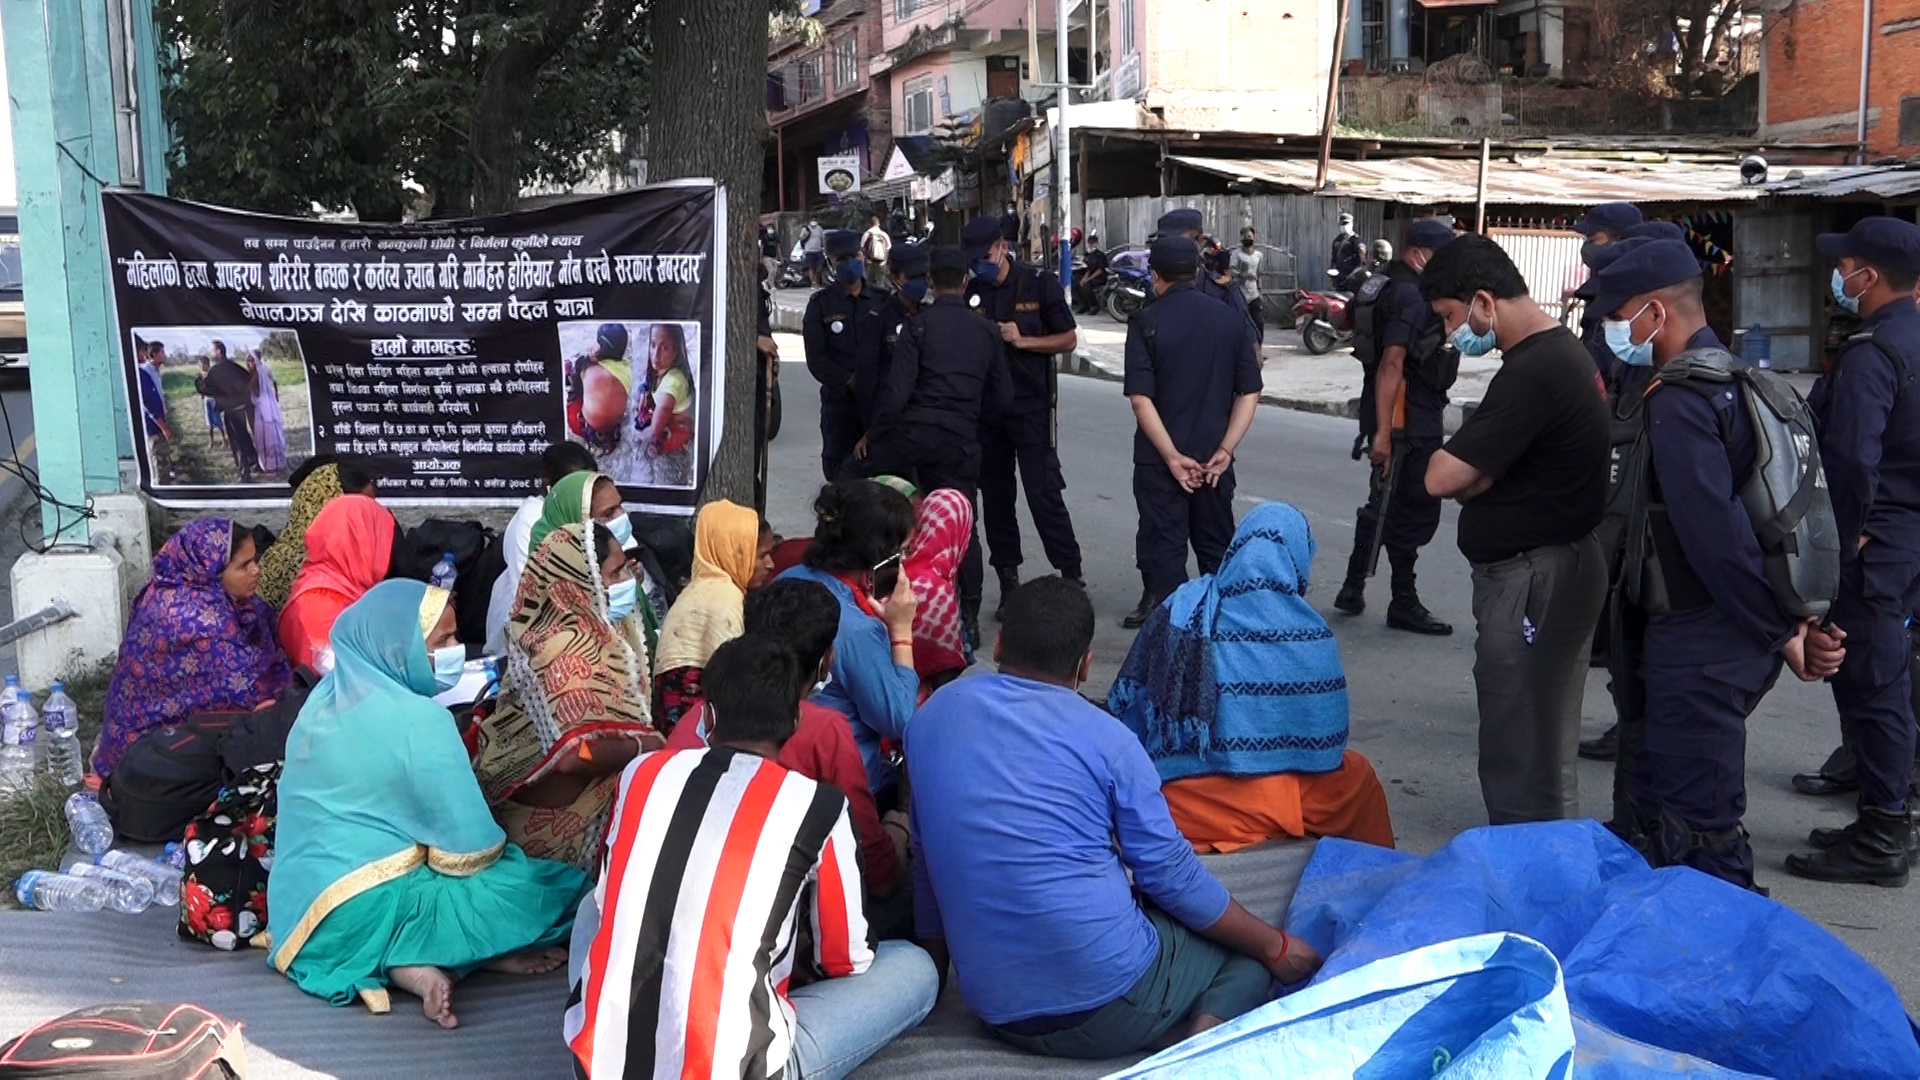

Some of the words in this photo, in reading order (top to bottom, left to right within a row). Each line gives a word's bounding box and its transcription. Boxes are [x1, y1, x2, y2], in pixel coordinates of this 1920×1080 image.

[352, 262, 362, 292] र
[403, 262, 435, 290] ज्यान
[613, 254, 654, 284] सरकार
[460, 301, 503, 323] सम्म
[506, 294, 548, 321] पैदल
[553, 297, 594, 317] यात्रा
[371, 333, 407, 358] हाम्रो
